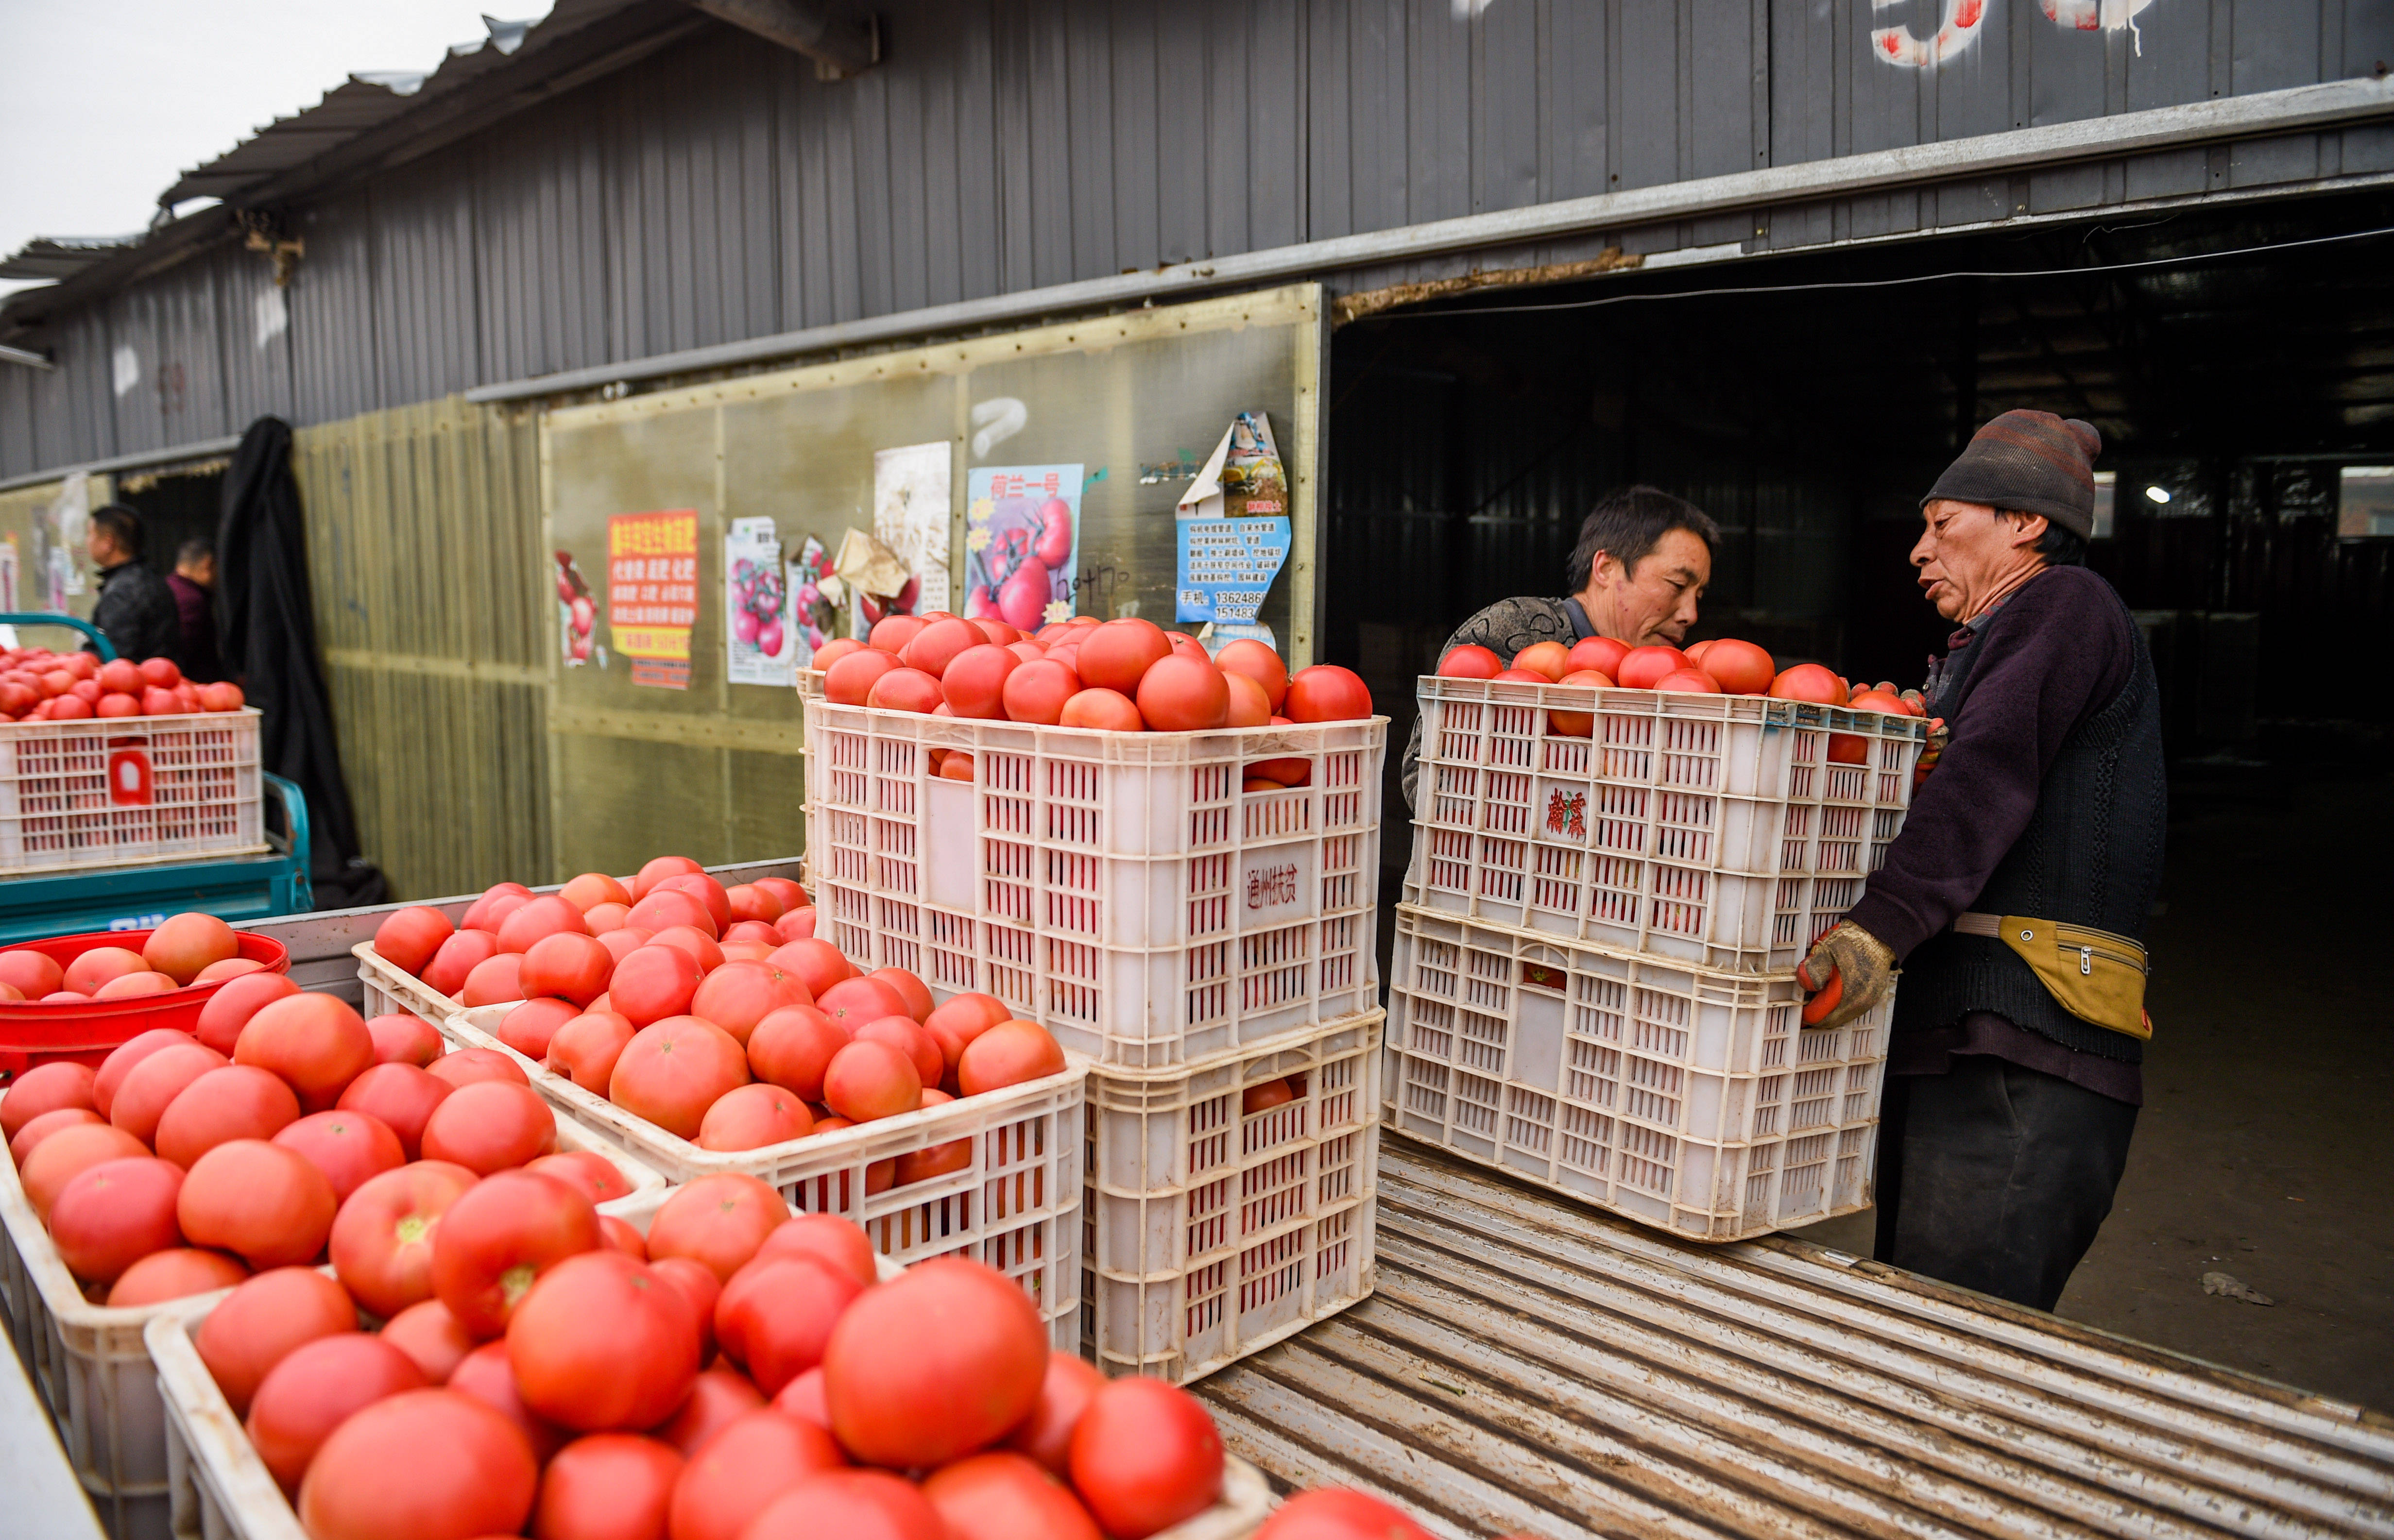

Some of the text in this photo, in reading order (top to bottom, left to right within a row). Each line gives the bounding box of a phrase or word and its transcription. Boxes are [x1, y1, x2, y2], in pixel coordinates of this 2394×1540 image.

[991, 472, 1060, 499] 荷兰一号
[1216, 608, 1255, 619] 151483
[1247, 862, 1298, 910] 通州扶贫
